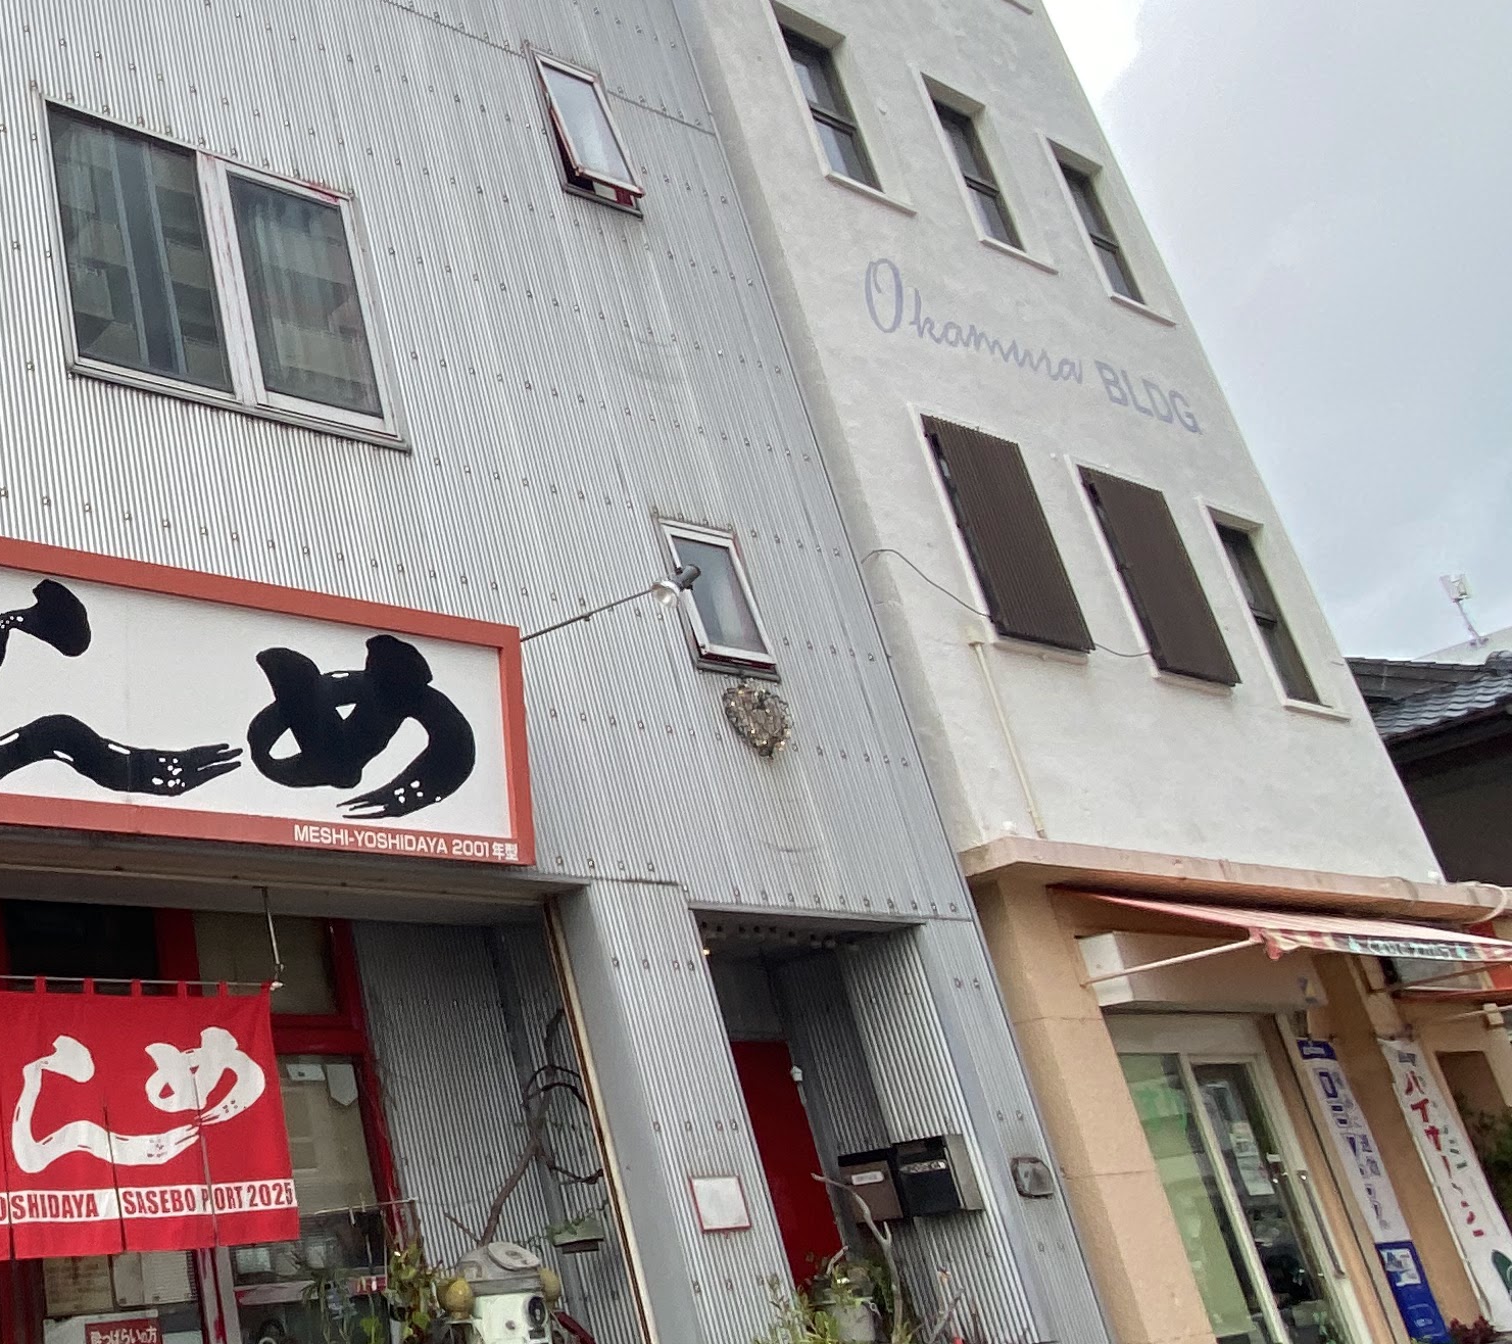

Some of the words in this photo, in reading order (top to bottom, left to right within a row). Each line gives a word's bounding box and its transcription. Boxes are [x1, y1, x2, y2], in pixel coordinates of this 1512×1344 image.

[1093, 359, 1203, 434] BLDG
[294, 824, 448, 854] MESHI-YOSHIDAYA
[452, 839, 519, 862] 2001年型
[122, 1188, 196, 1215] SASEBO
[202, 1186, 243, 1213] PORT
[247, 1182, 294, 1208] 2025
